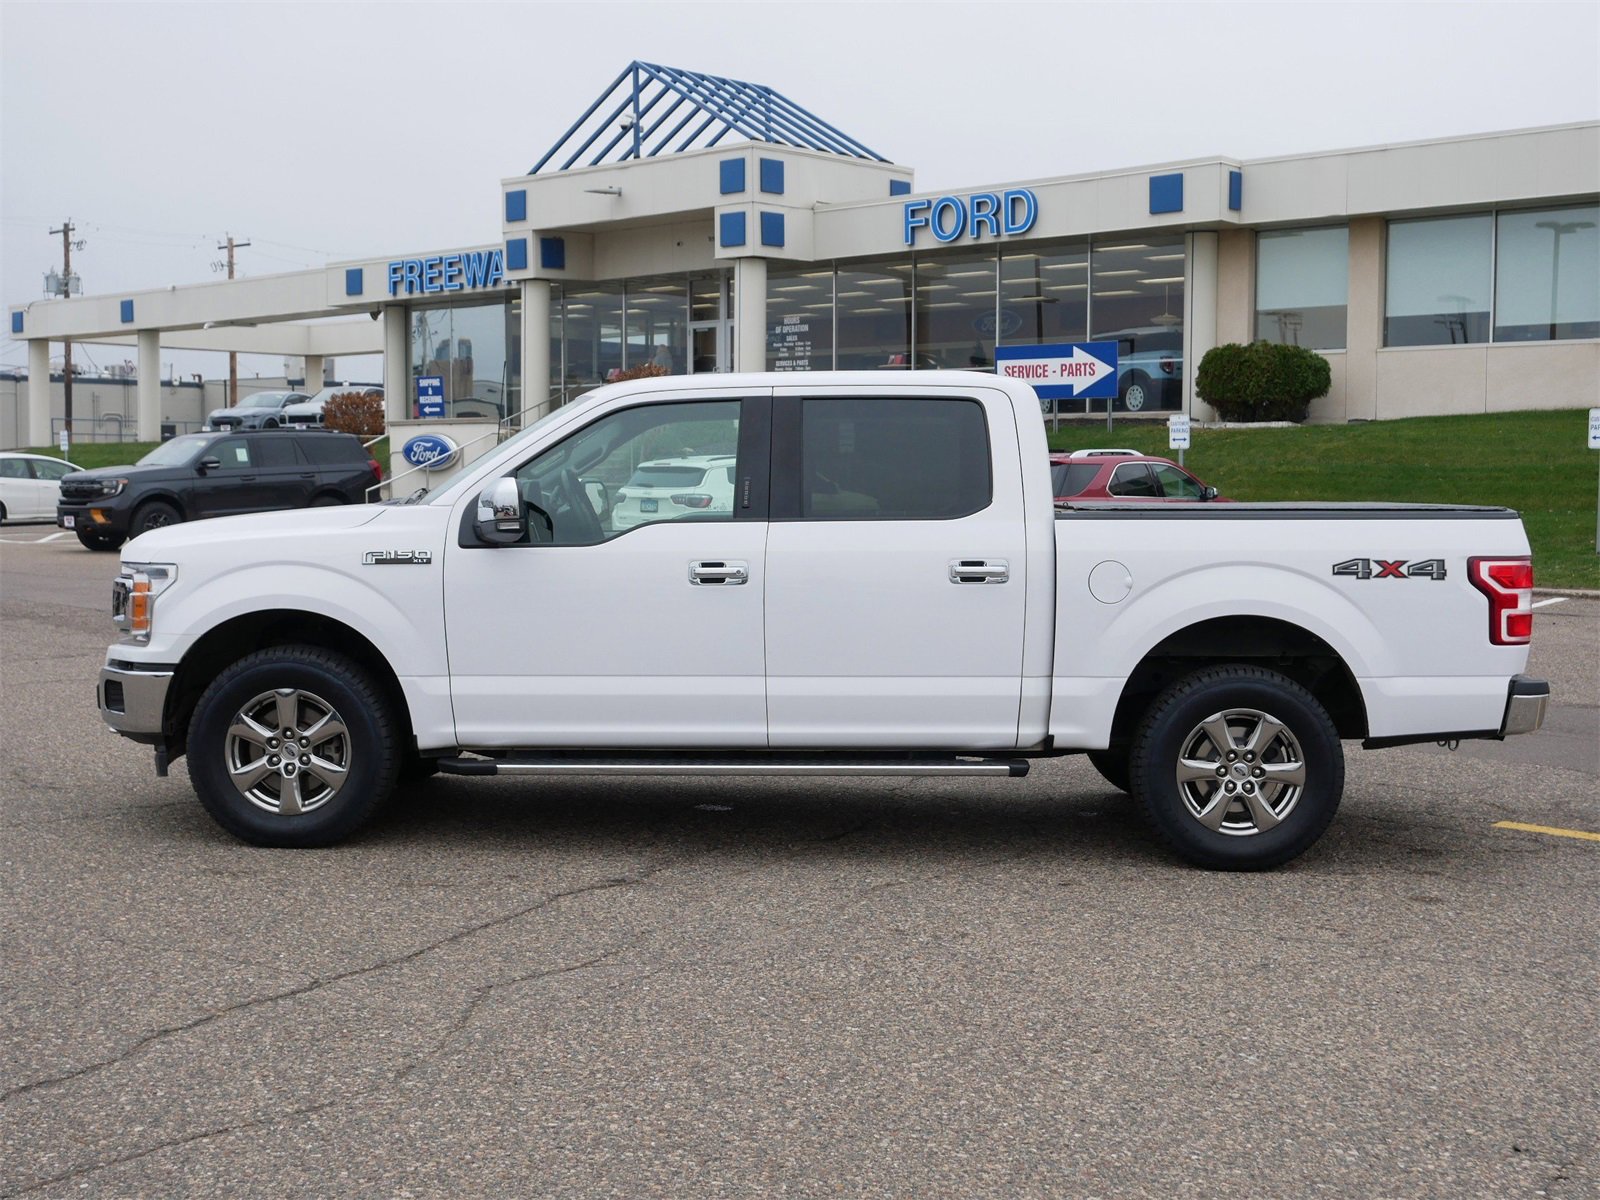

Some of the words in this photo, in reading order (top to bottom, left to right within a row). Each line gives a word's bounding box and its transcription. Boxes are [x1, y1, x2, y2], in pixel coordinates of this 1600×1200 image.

[904, 187, 1038, 245] FORD
[388, 249, 504, 296] FREEWA
[783, 324, 808, 333] OPERATION
[1004, 364, 1049, 379] SERVICE
[1060, 362, 1096, 377] PARTS
[411, 441, 440, 462] Ford
